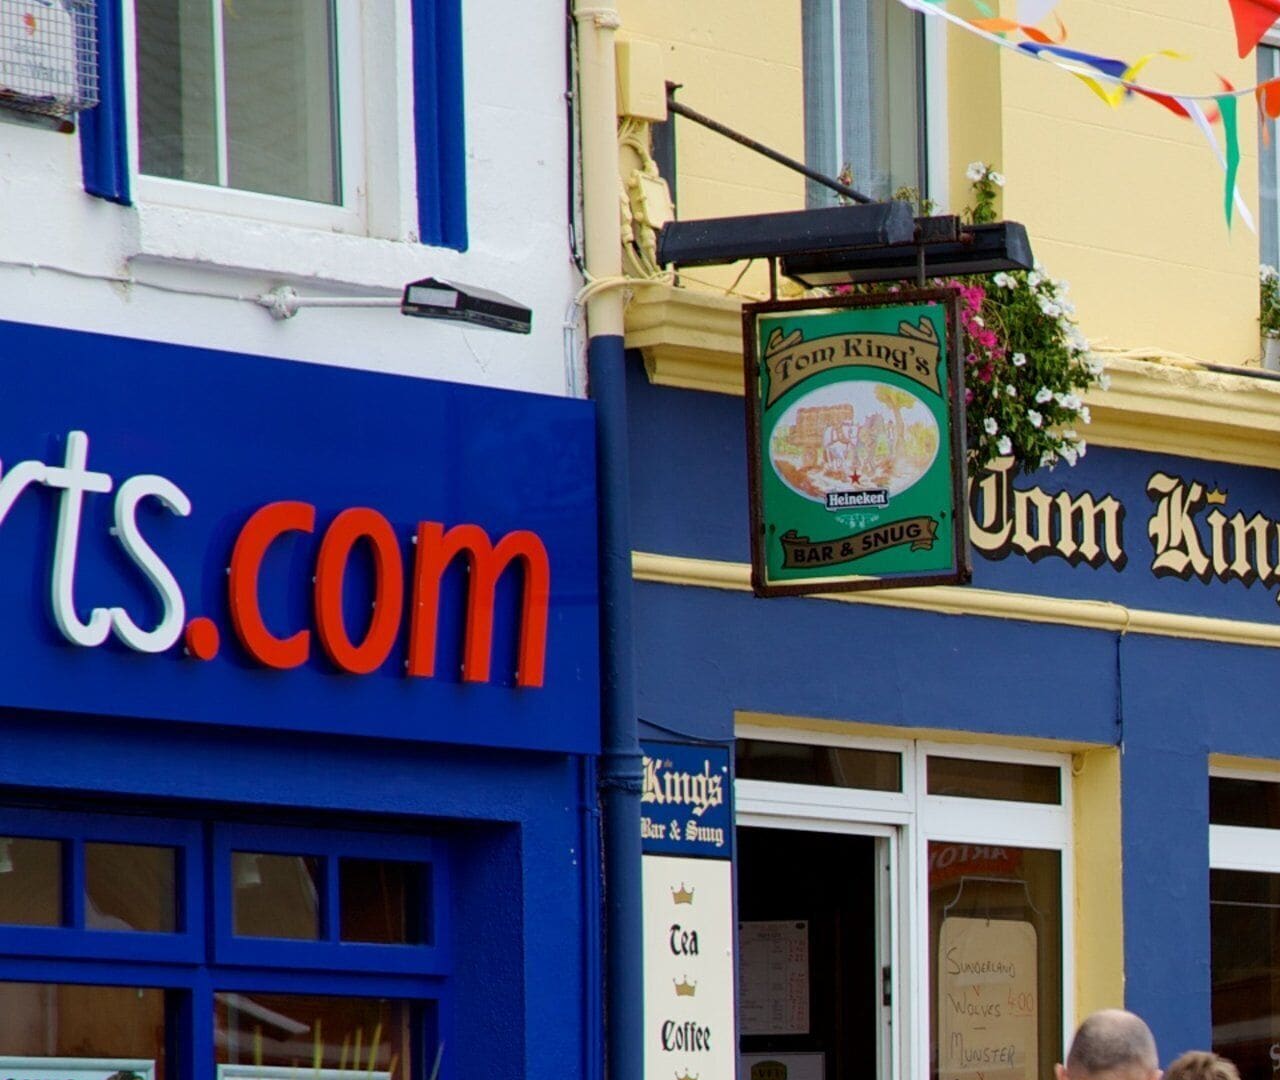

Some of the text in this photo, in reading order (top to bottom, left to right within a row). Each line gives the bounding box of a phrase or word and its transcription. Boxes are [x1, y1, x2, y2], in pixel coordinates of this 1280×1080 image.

[774, 337, 930, 383] Tom King's
[829, 490, 887, 508] Heineken
[968, 455, 1123, 563] Tom
[793, 523, 922, 564] BAR & SNUG
[640, 755, 723, 817] King's
[640, 817, 725, 848] Bar & Snug
[670, 923, 699, 956] Tea
[660, 1019, 711, 1052] Coffee
